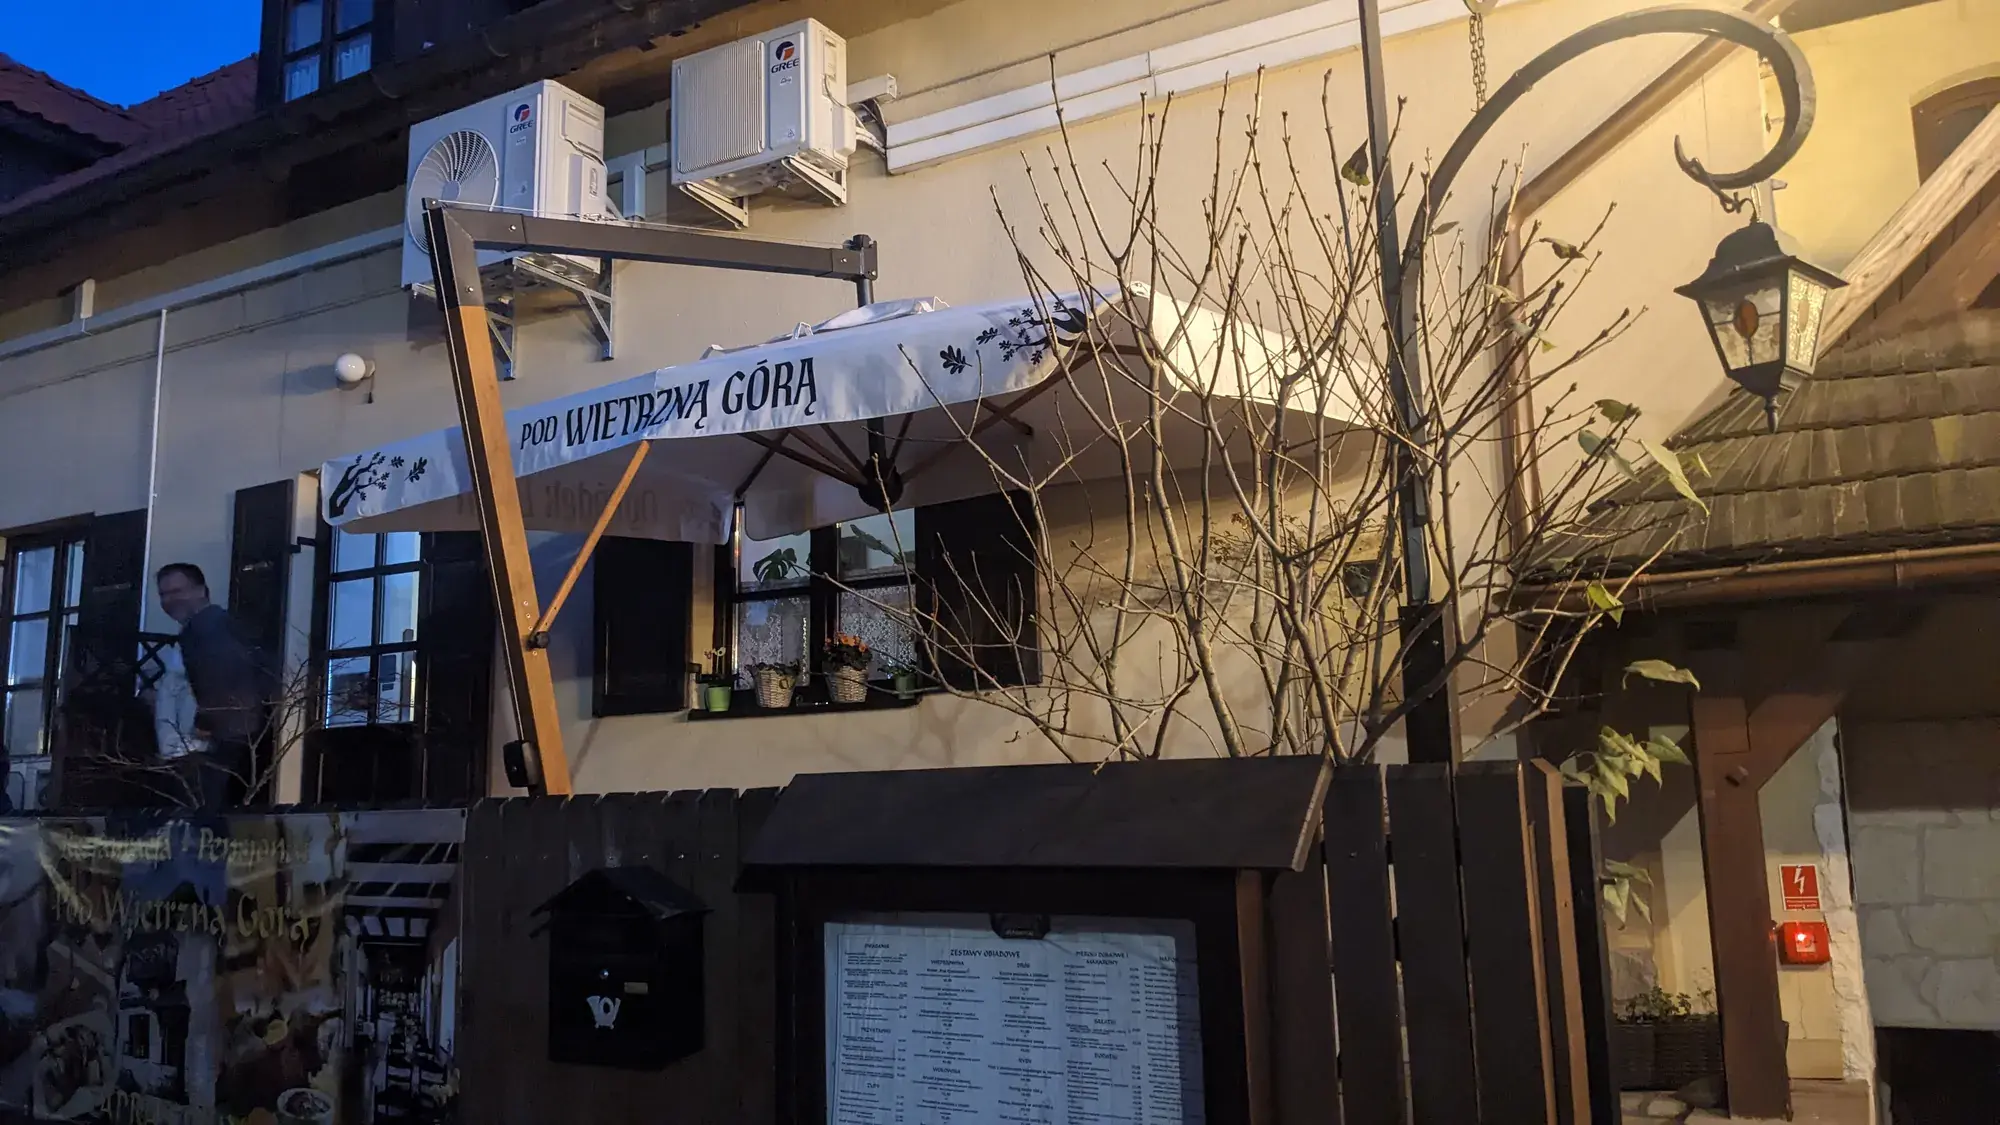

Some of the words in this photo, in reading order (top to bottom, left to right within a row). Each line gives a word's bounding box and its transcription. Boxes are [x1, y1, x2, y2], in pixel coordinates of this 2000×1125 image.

[770, 57, 800, 74] GREE
[509, 119, 534, 134] GREE
[520, 415, 558, 450] POD
[566, 379, 711, 447] WIETRZNĄ
[722, 356, 818, 416] GÓRĄ
[950, 948, 982, 957] ZESTAWY
[983, 949, 1020, 959] OBIADOWE
